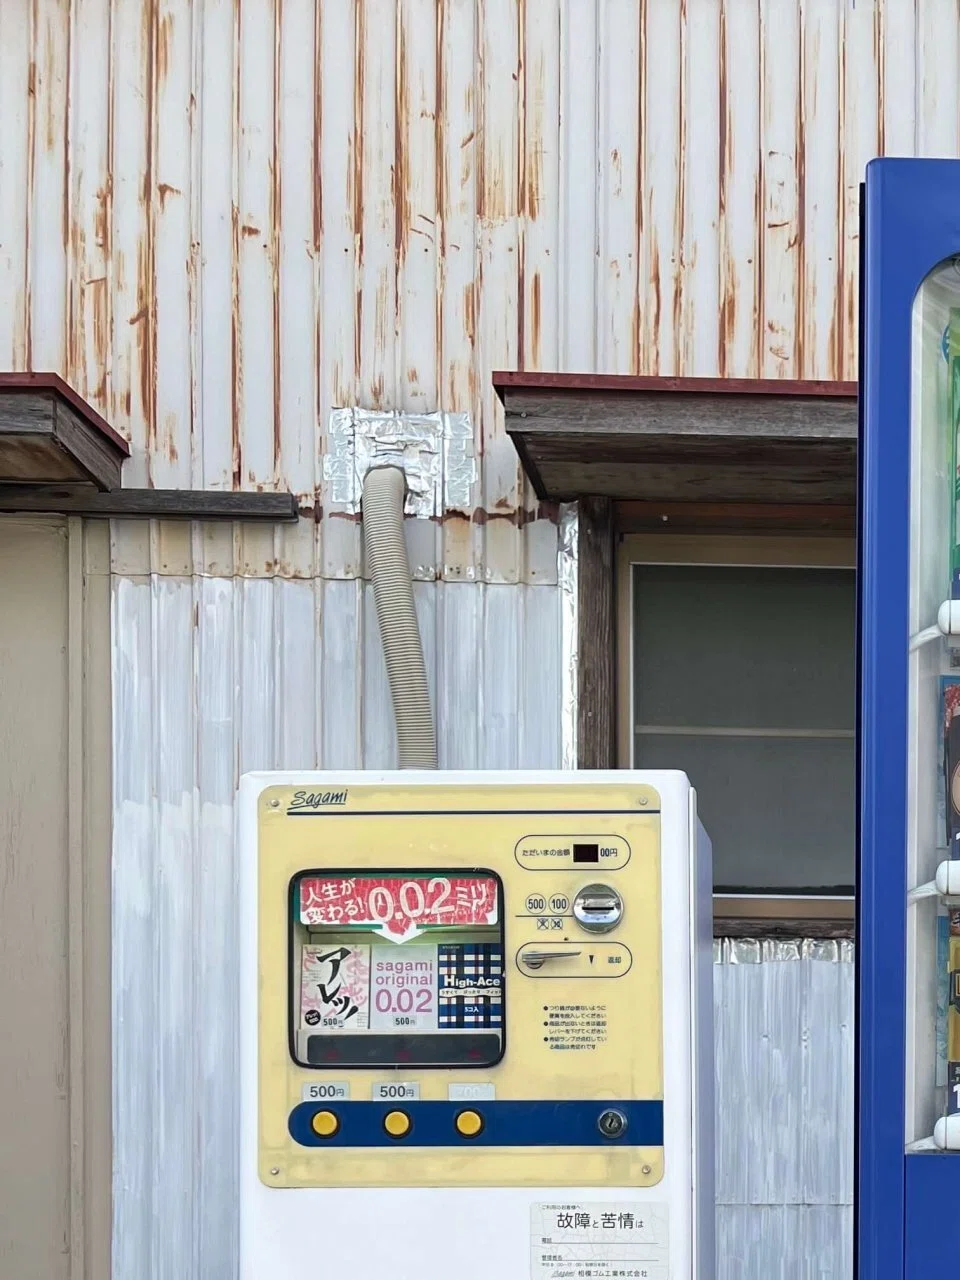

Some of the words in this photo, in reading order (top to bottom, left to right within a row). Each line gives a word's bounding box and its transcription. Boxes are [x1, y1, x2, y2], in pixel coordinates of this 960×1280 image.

[290, 789, 349, 808] Sagami
[305, 877, 357, 905] 人生が
[368, 878, 455, 922] 0.02
[456, 883, 489, 910] ミリ
[528, 898, 544, 909] 500
[551, 898, 567, 909] 100
[376, 960, 433, 973] sagami
[375, 973, 433, 988] original
[444, 974, 501, 988] High-Ace
[375, 989, 433, 1013] 0.02
[309, 1085, 344, 1098] 500円
[380, 1085, 415, 1098] 500円
[557, 1212, 644, 1229] 故障と苦情は
